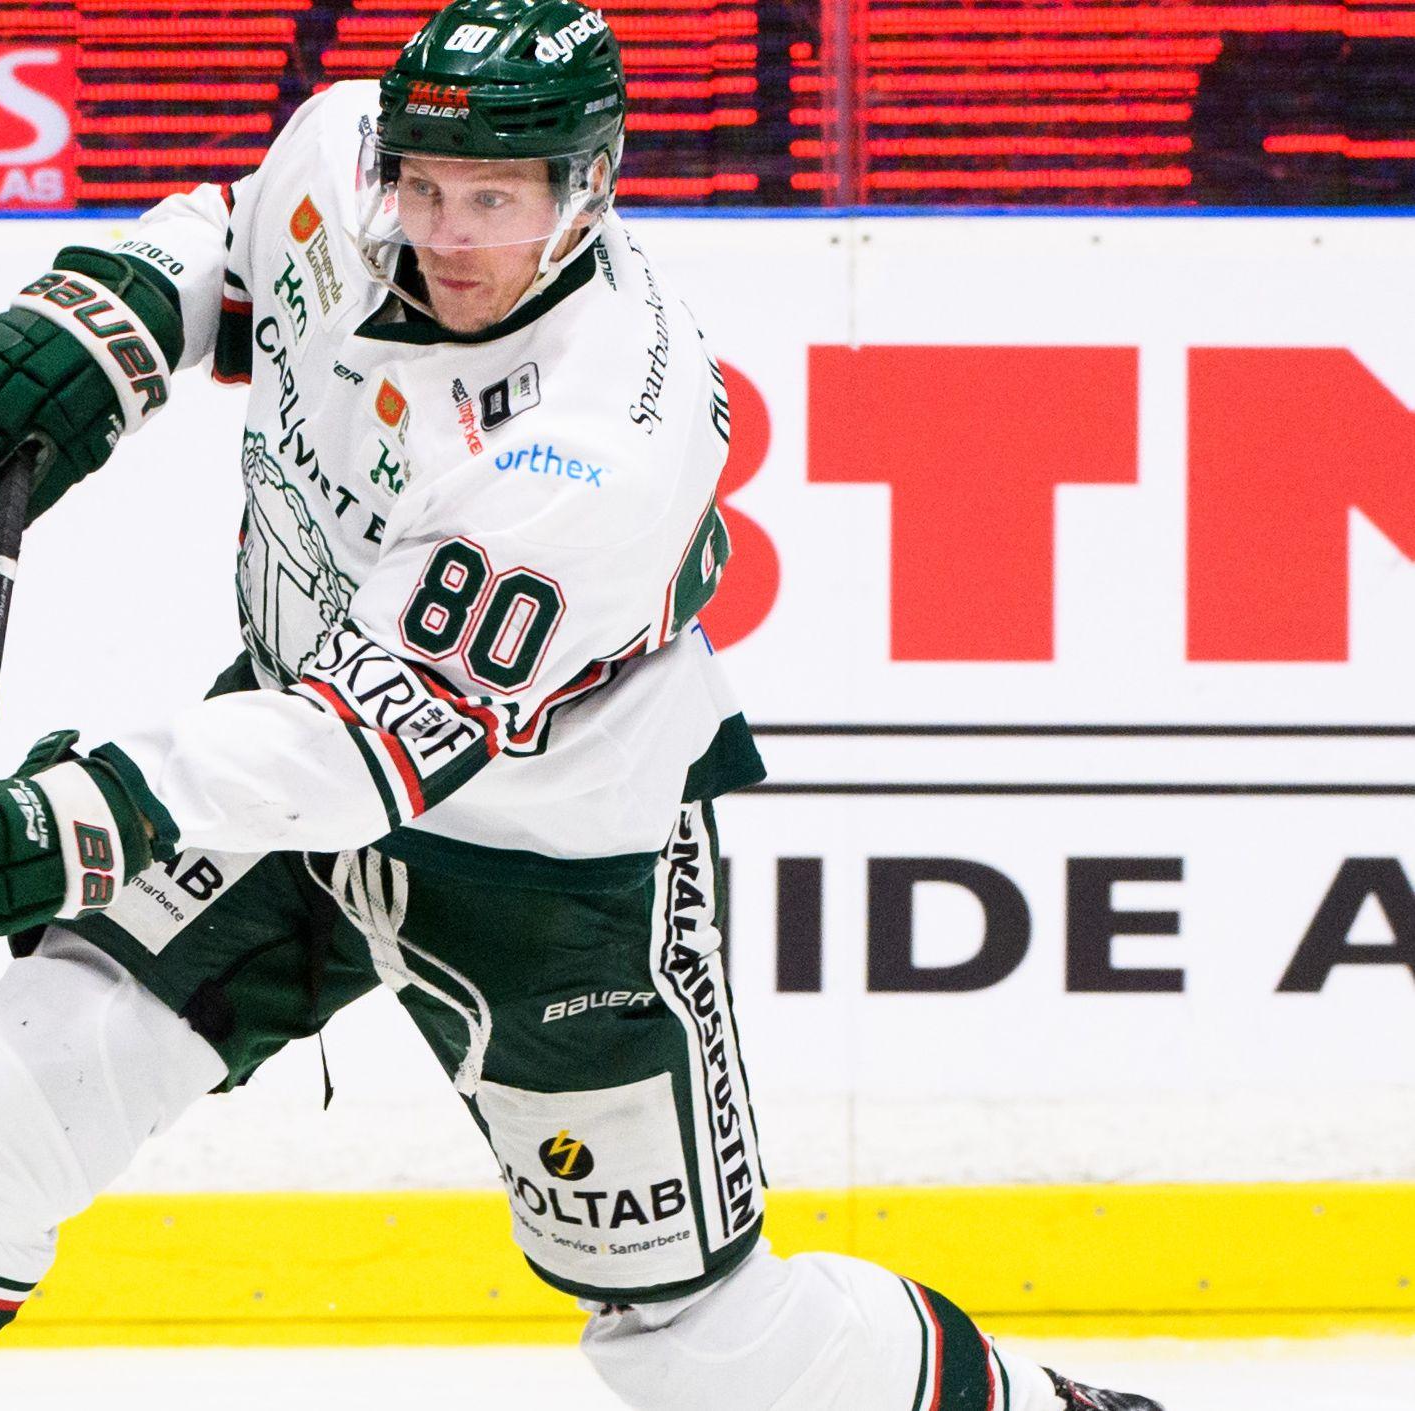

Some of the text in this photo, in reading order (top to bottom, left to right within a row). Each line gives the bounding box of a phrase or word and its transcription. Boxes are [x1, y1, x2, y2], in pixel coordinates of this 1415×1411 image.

[444, 24, 497, 53] 80
[405, 103, 470, 120] BAUER
[19, 272, 169, 417] BAUER
[495, 443, 603, 488] orthex
[398, 535, 567, 696] 80
[131, 875, 186, 922] marbete
[542, 990, 657, 1024] BAUER
[609, 1229, 691, 1256] Samarbete
